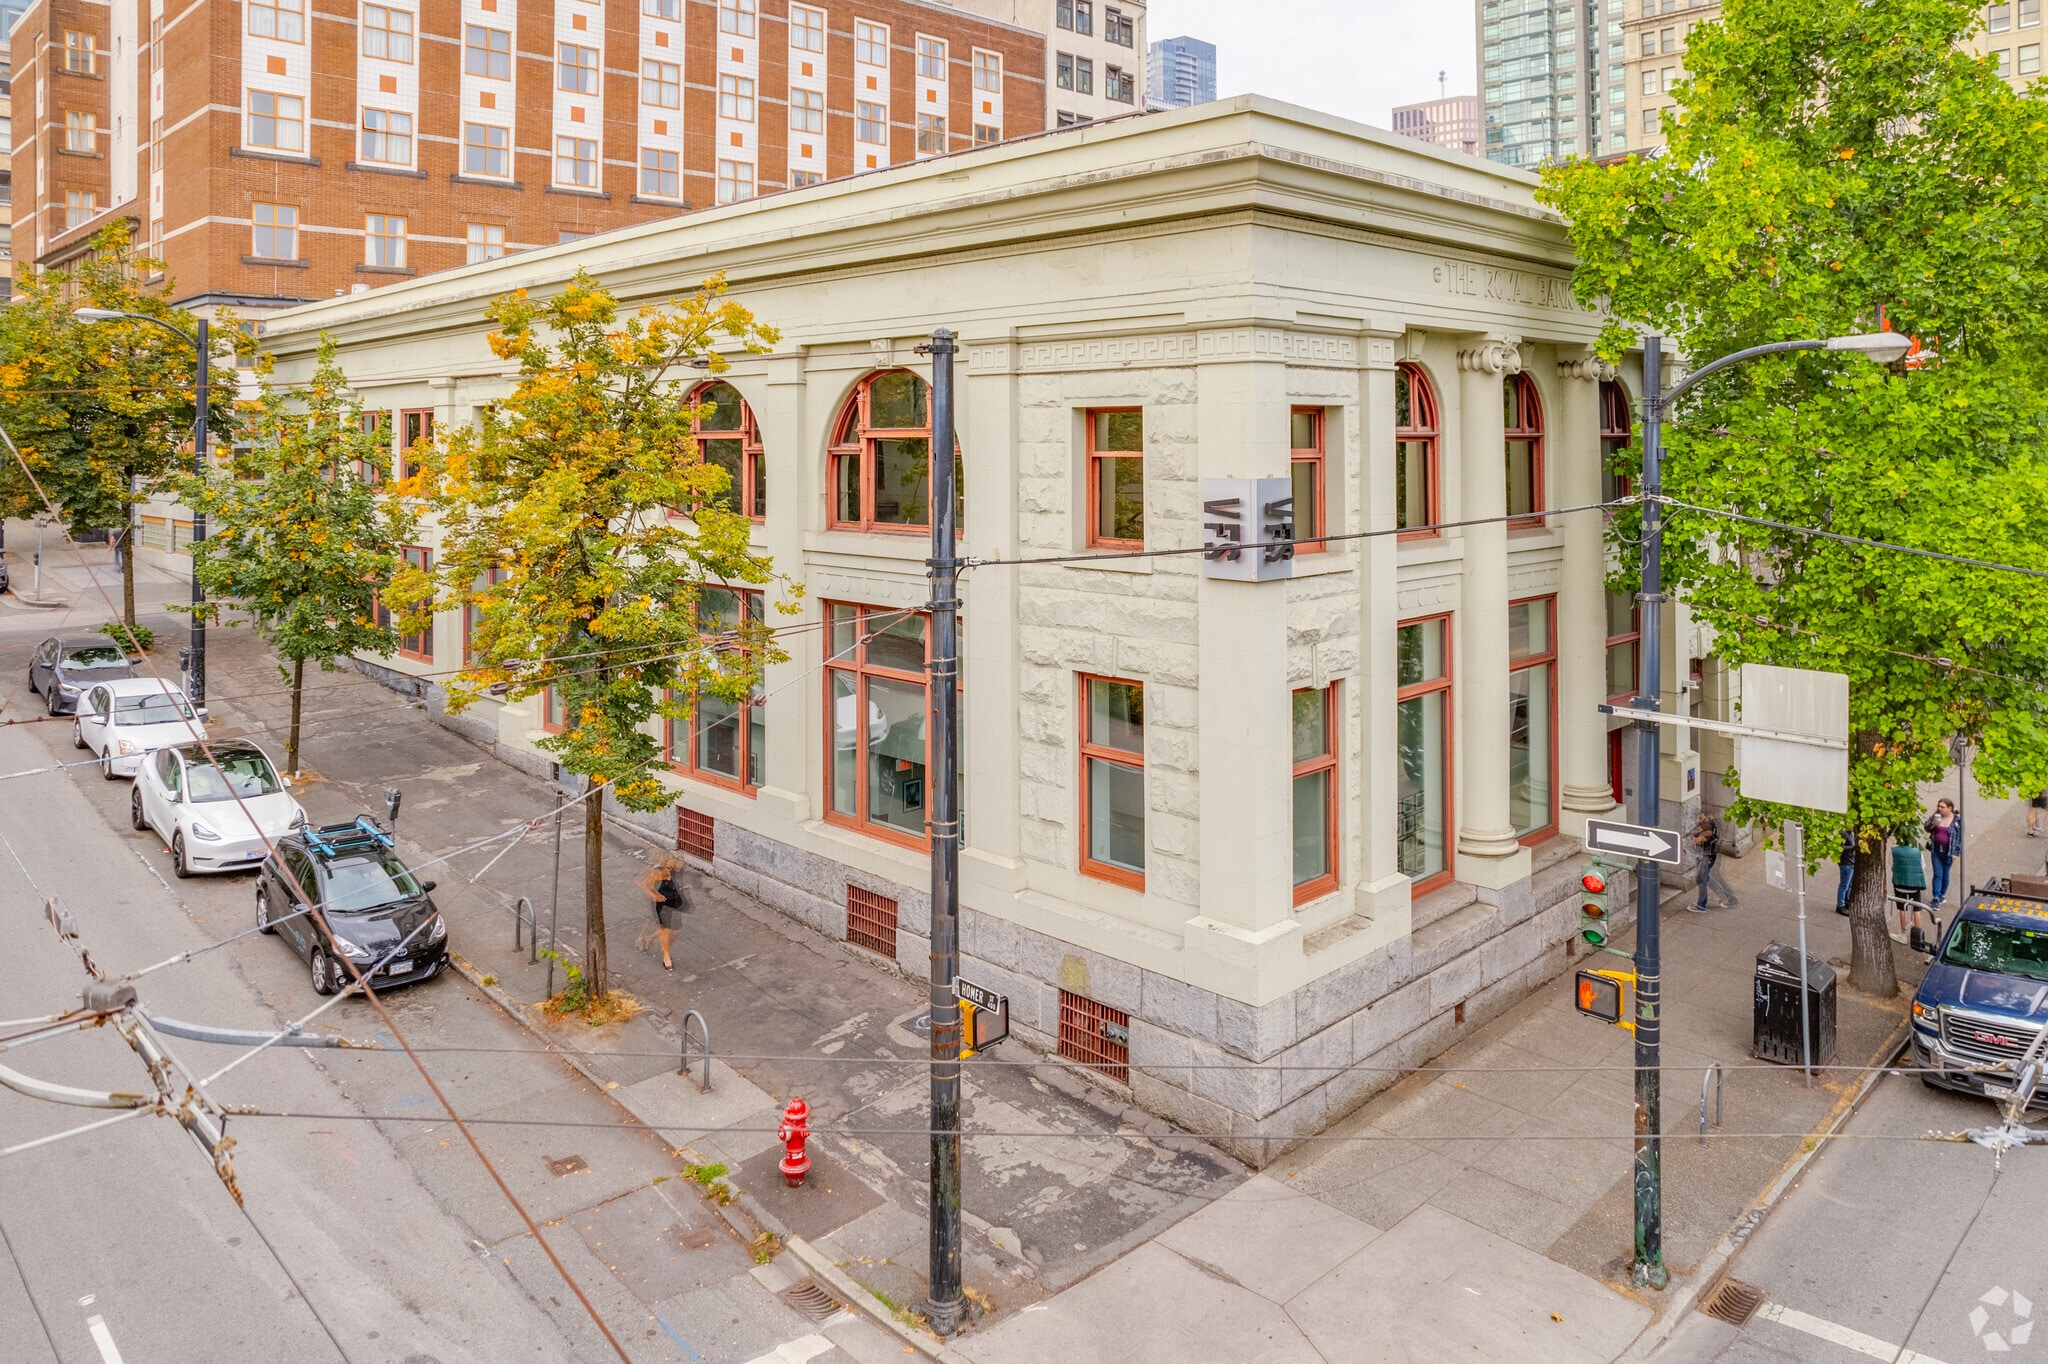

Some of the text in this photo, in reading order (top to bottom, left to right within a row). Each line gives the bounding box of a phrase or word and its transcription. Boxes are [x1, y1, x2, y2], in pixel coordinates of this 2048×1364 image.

[1444, 261, 1477, 296] THE
[1484, 267, 1533, 305] ROYAL
[1537, 276, 1575, 310] BANK
[961, 982, 984, 1005] HOMER
[1974, 1030, 2019, 1049] GMC
